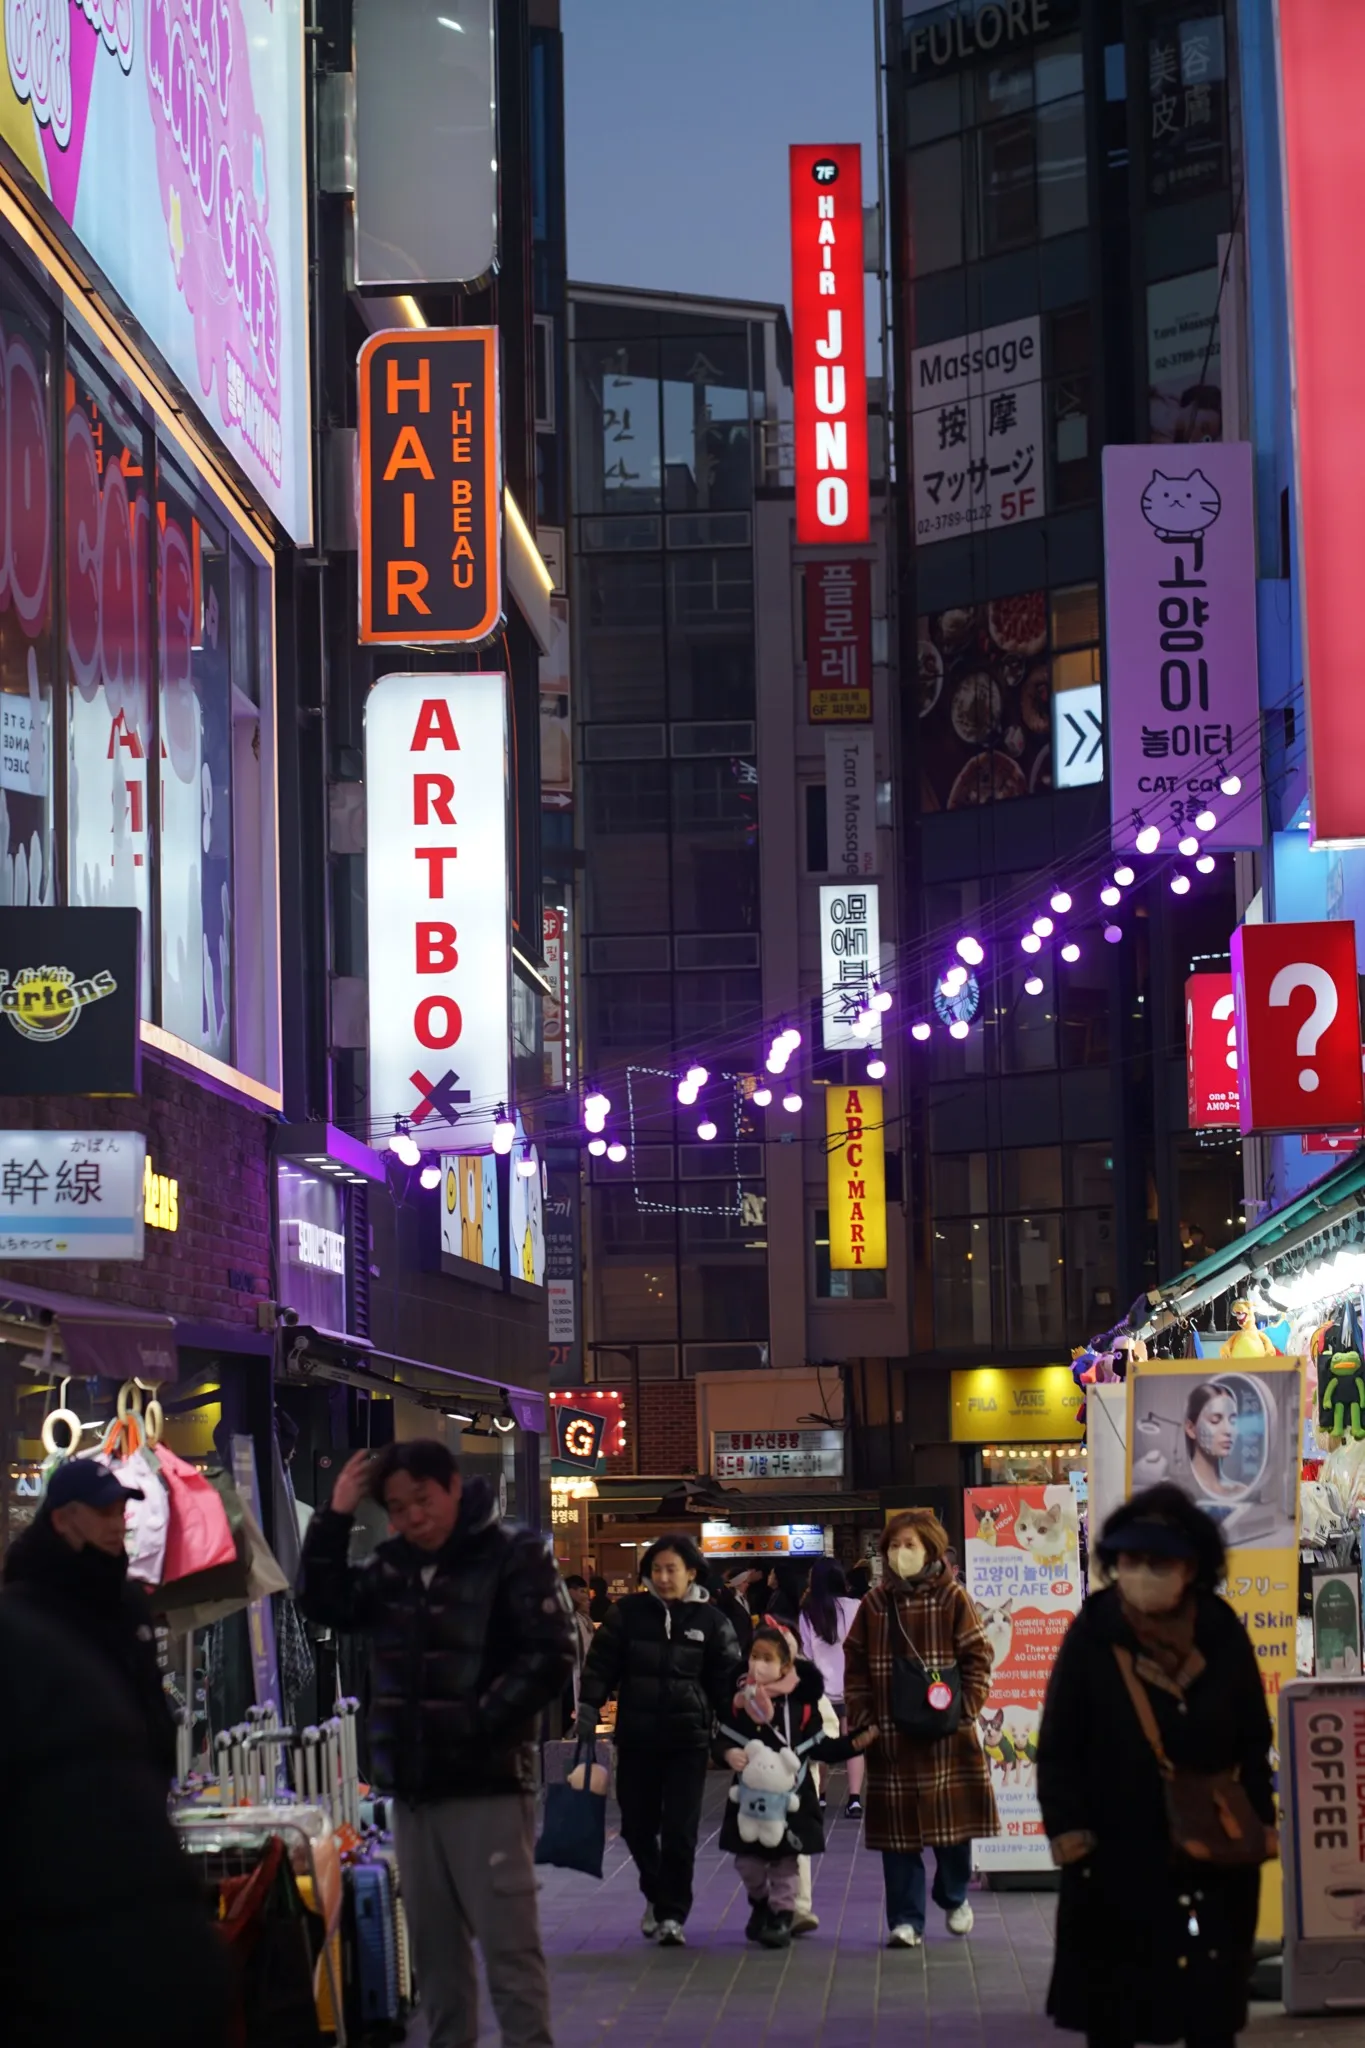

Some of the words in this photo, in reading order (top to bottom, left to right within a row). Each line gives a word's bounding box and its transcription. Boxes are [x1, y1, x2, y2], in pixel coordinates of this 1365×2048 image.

[910, 0, 1051, 73] FULORE
[816, 165, 835, 180] 7F
[217, 143, 279, 389] CAFE
[817, 195, 836, 295] HAIR
[920, 334, 1034, 388] Massage
[451, 382, 472, 464] THE
[814, 308, 849, 526] JUNO
[938, 393, 1018, 450] 按摩
[384, 359, 435, 616] HAIR
[923, 444, 1035, 505] マッサージ
[917, 503, 993, 535] 02-3789-0122
[1000, 487, 1036, 521] 5F
[451, 480, 475, 589] BEAU
[818, 565, 859, 686] 플로레
[1158, 537, 1210, 713] 고양이
[1140, 723, 1233, 758] 놀이터
[843, 745, 859, 788] T.ara
[1137, 775, 1178, 793] CAT
[1186, 775, 1223, 793] caf
[840, 794, 861, 876] Massage
[409, 697, 471, 1125] ARTBOX
[0, 969, 118, 1012] artens
[1208, 1093, 1226, 1101] one
[1228, 1091, 1240, 1101] Da
[70, 1138, 120, 1153] かばん
[1, 1158, 103, 1205] 幹線
[844, 1089, 866, 1265] ABC-MART
[967, 1397, 998, 1412] FILA
[1012, 1389, 1045, 1408] VANS
[748, 1455, 769, 1476] 가방
[772, 1454, 790, 1475] 구두
[973, 1564, 1018, 1582] 고양이
[973, 1584, 1003, 1597] CAT
[1008, 1583, 1049, 1596] CAFE
[1055, 1583, 1069, 1594] 3F
[1254, 1612, 1294, 1629] Skin
[1025, 1643, 1050, 1653] There
[1308, 1712, 1348, 1850] COFFEE
